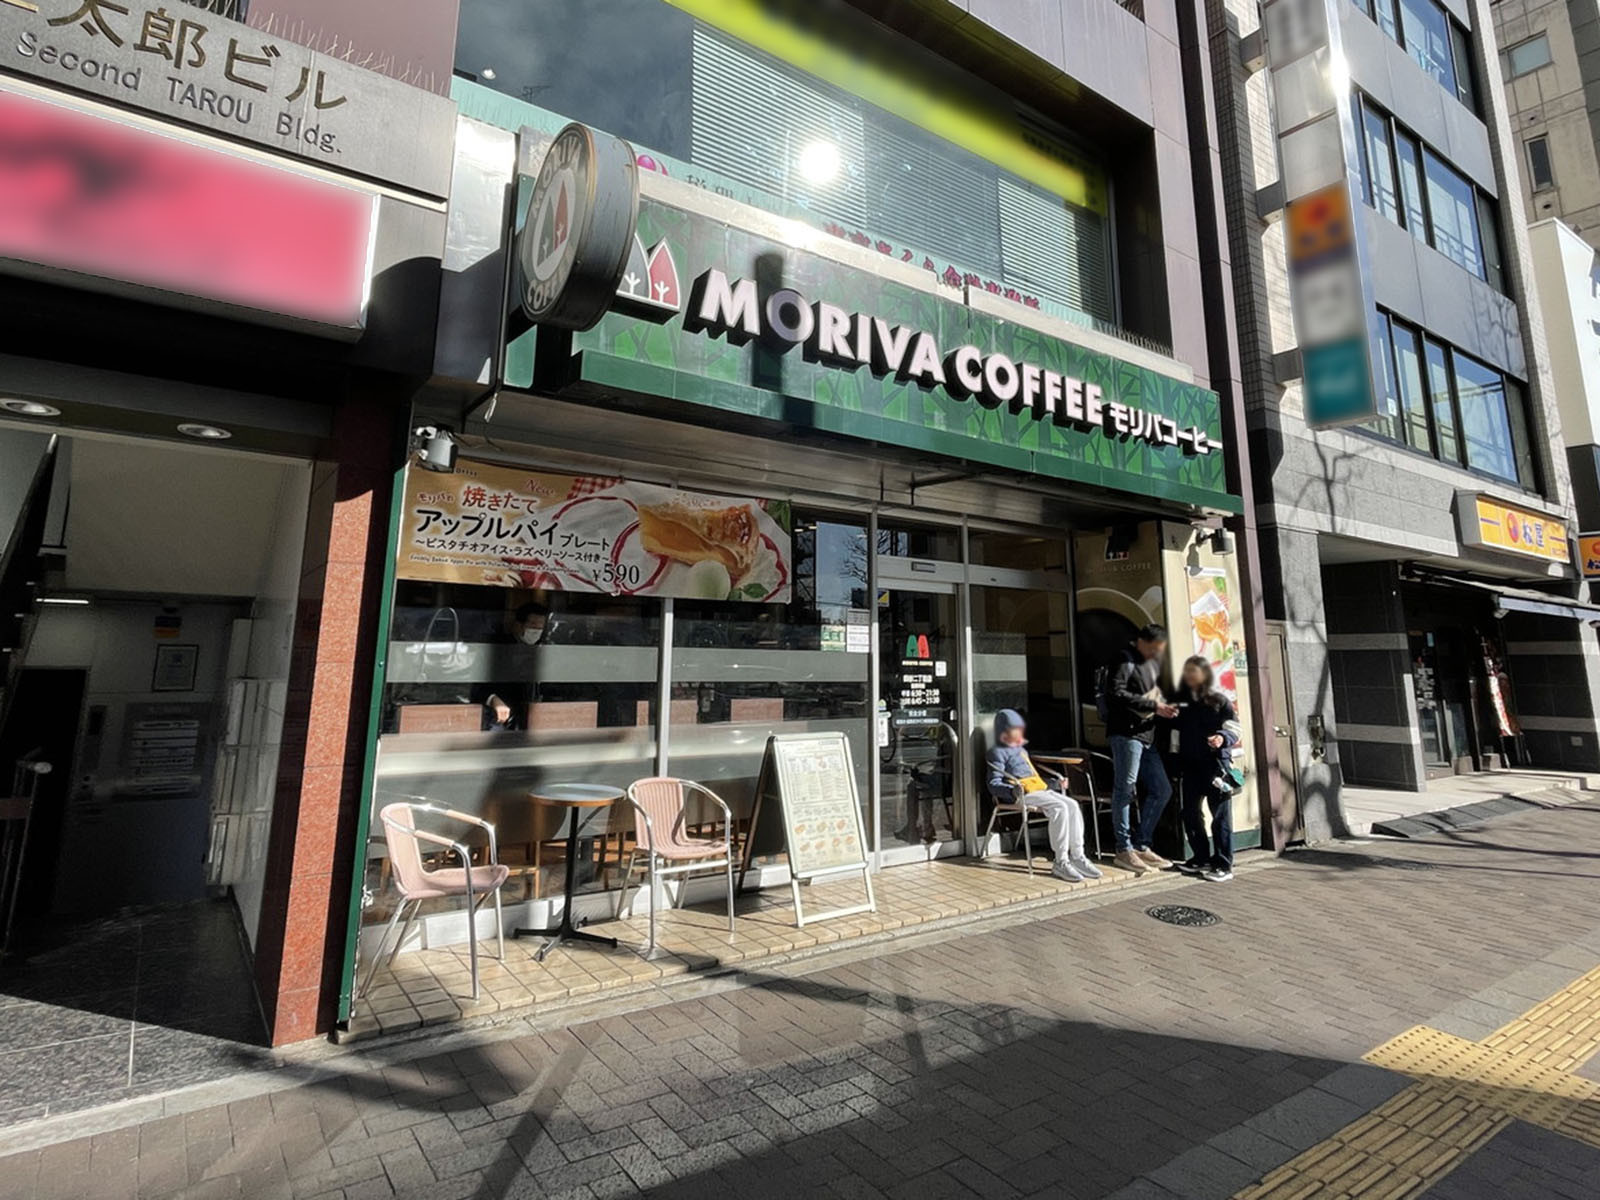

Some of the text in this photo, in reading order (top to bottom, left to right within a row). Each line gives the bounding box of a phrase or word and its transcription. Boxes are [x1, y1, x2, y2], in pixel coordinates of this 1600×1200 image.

[0, 0, 347, 109] 太郎ビル
[16, 31, 342, 153] Second TAROU Bldg.
[698, 267, 1103, 426] MORIVA COFFEE
[1109, 401, 1223, 454] モリバコーヒー
[462, 486, 537, 514] 焼きたて
[592, 563, 640, 585] ¥590
